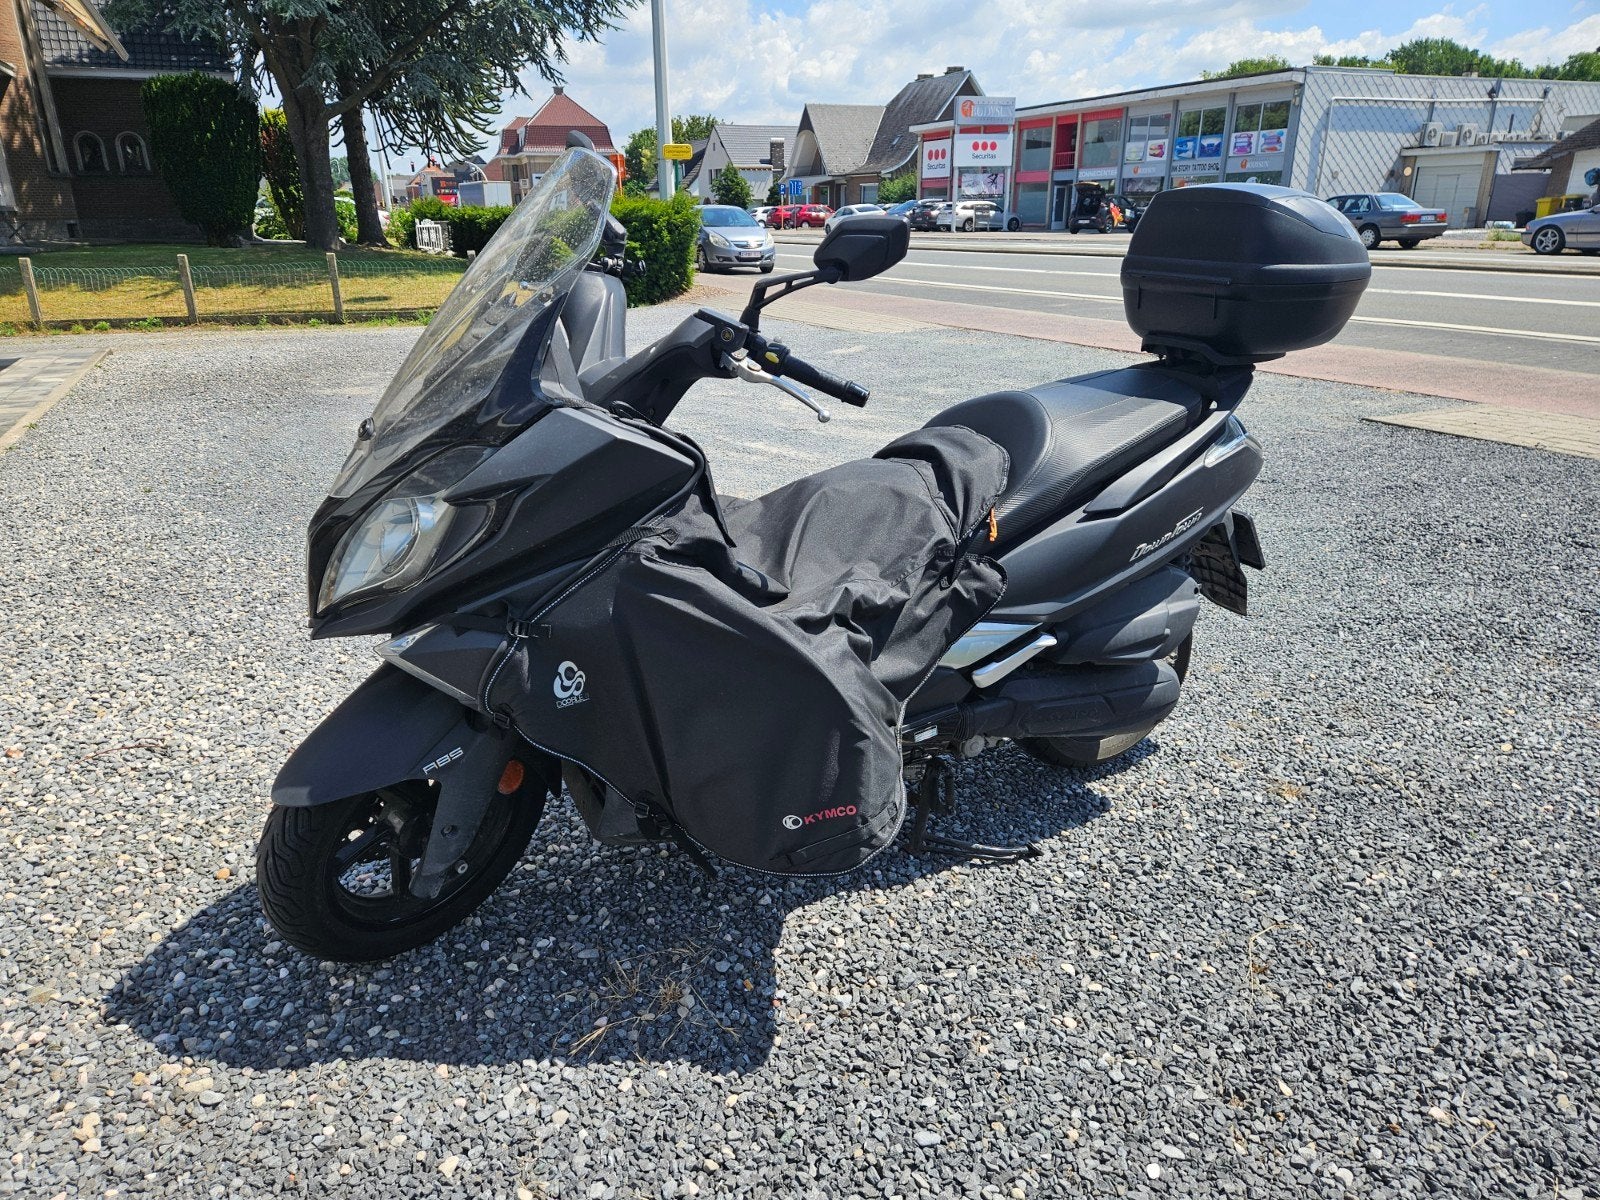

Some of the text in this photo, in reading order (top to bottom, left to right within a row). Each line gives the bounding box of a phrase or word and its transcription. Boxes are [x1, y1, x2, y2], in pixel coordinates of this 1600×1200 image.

[927, 162, 946, 170] Securitas
[422, 746, 465, 775] ABS
[803, 805, 857, 825] KYMCO
